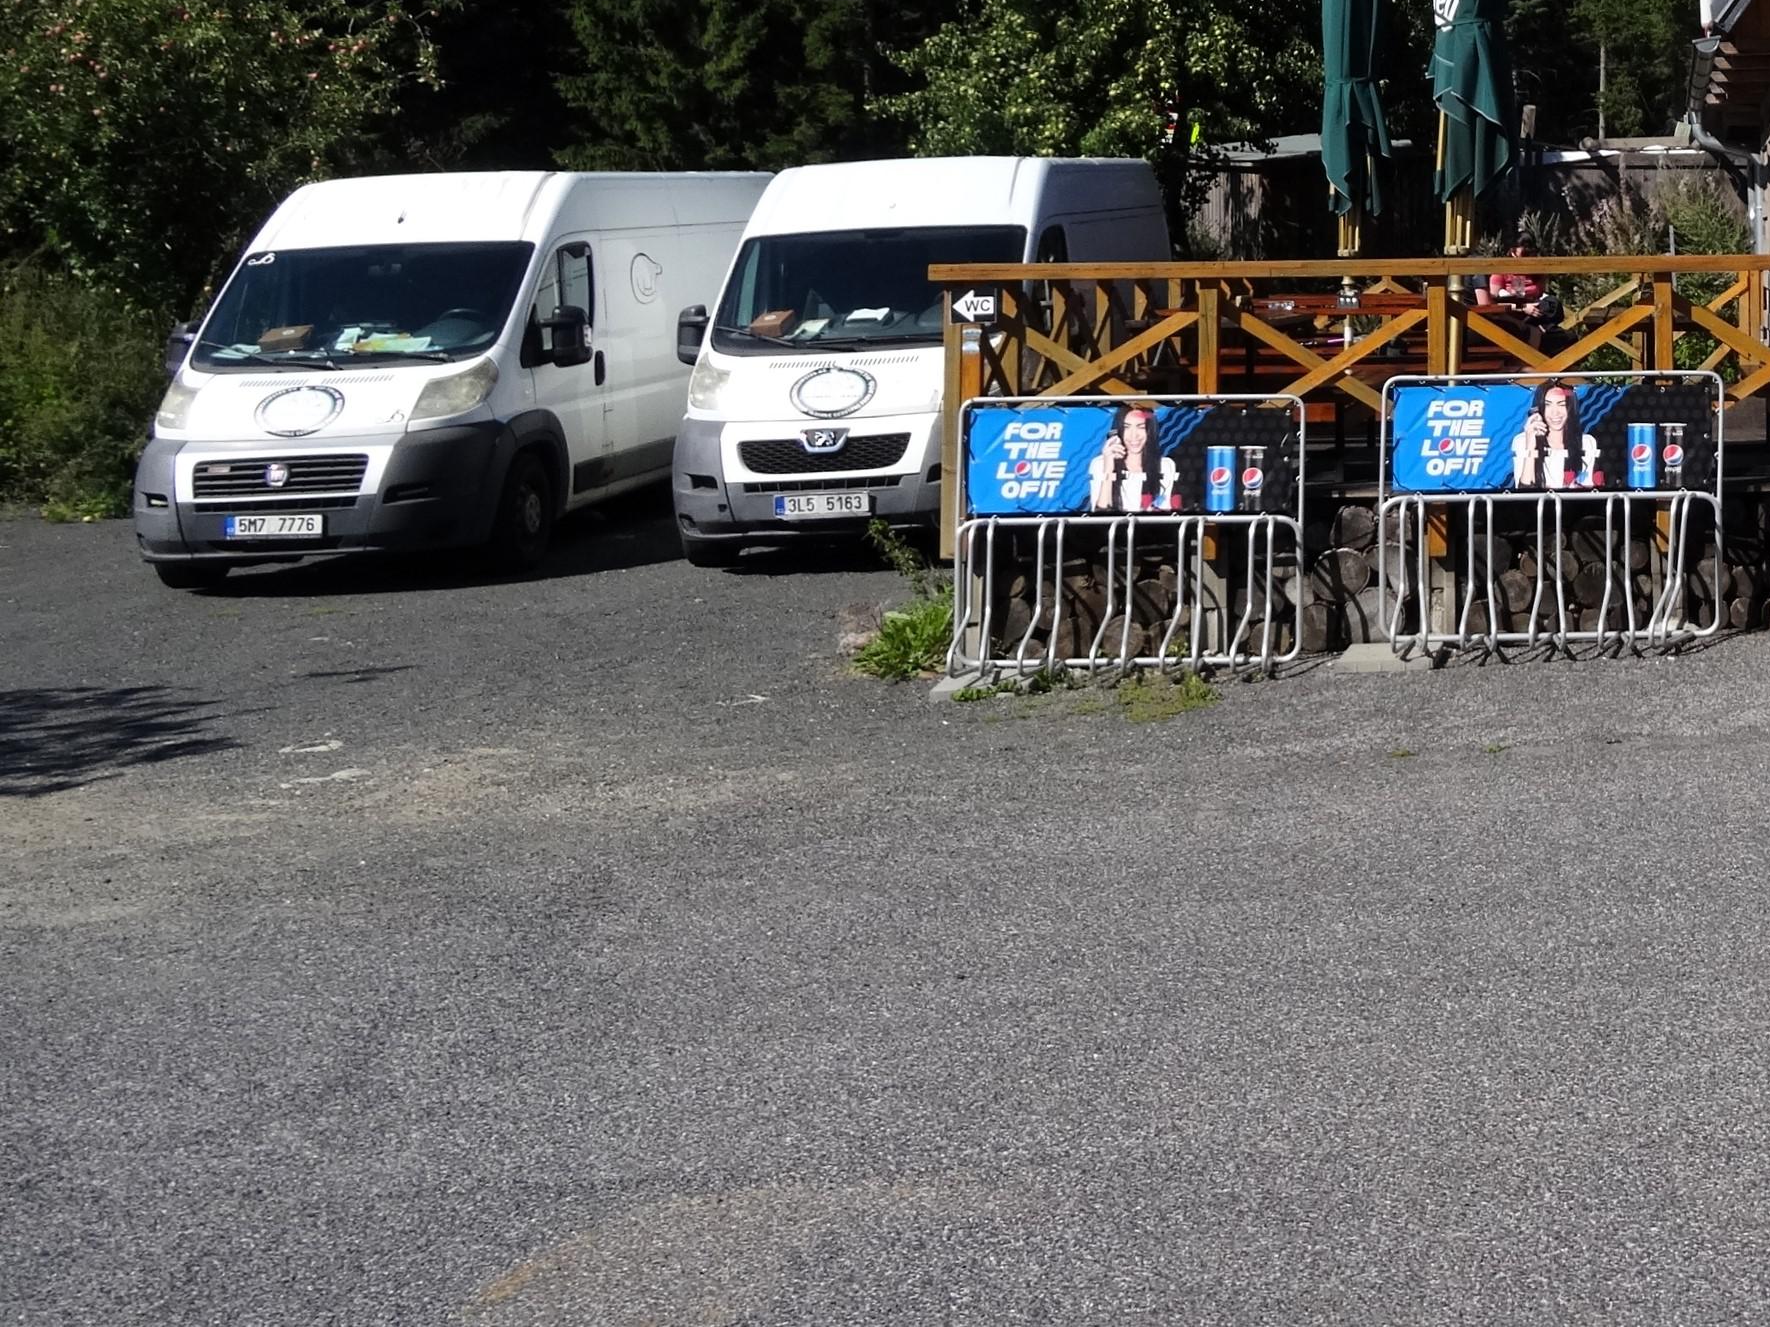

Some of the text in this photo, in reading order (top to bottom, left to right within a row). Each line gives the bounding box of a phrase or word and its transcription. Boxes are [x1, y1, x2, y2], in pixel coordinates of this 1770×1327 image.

[964, 299, 991, 312] WC
[1427, 400, 1485, 418] FOR
[1004, 422, 1064, 440] FOR
[1427, 419, 1485, 437] THE
[1003, 441, 1063, 460] THE
[788, 499, 815, 512] 3L5
[826, 496, 862, 511] 5163
[238, 518, 267, 533] 5M7
[278, 517, 315, 532] 7776
